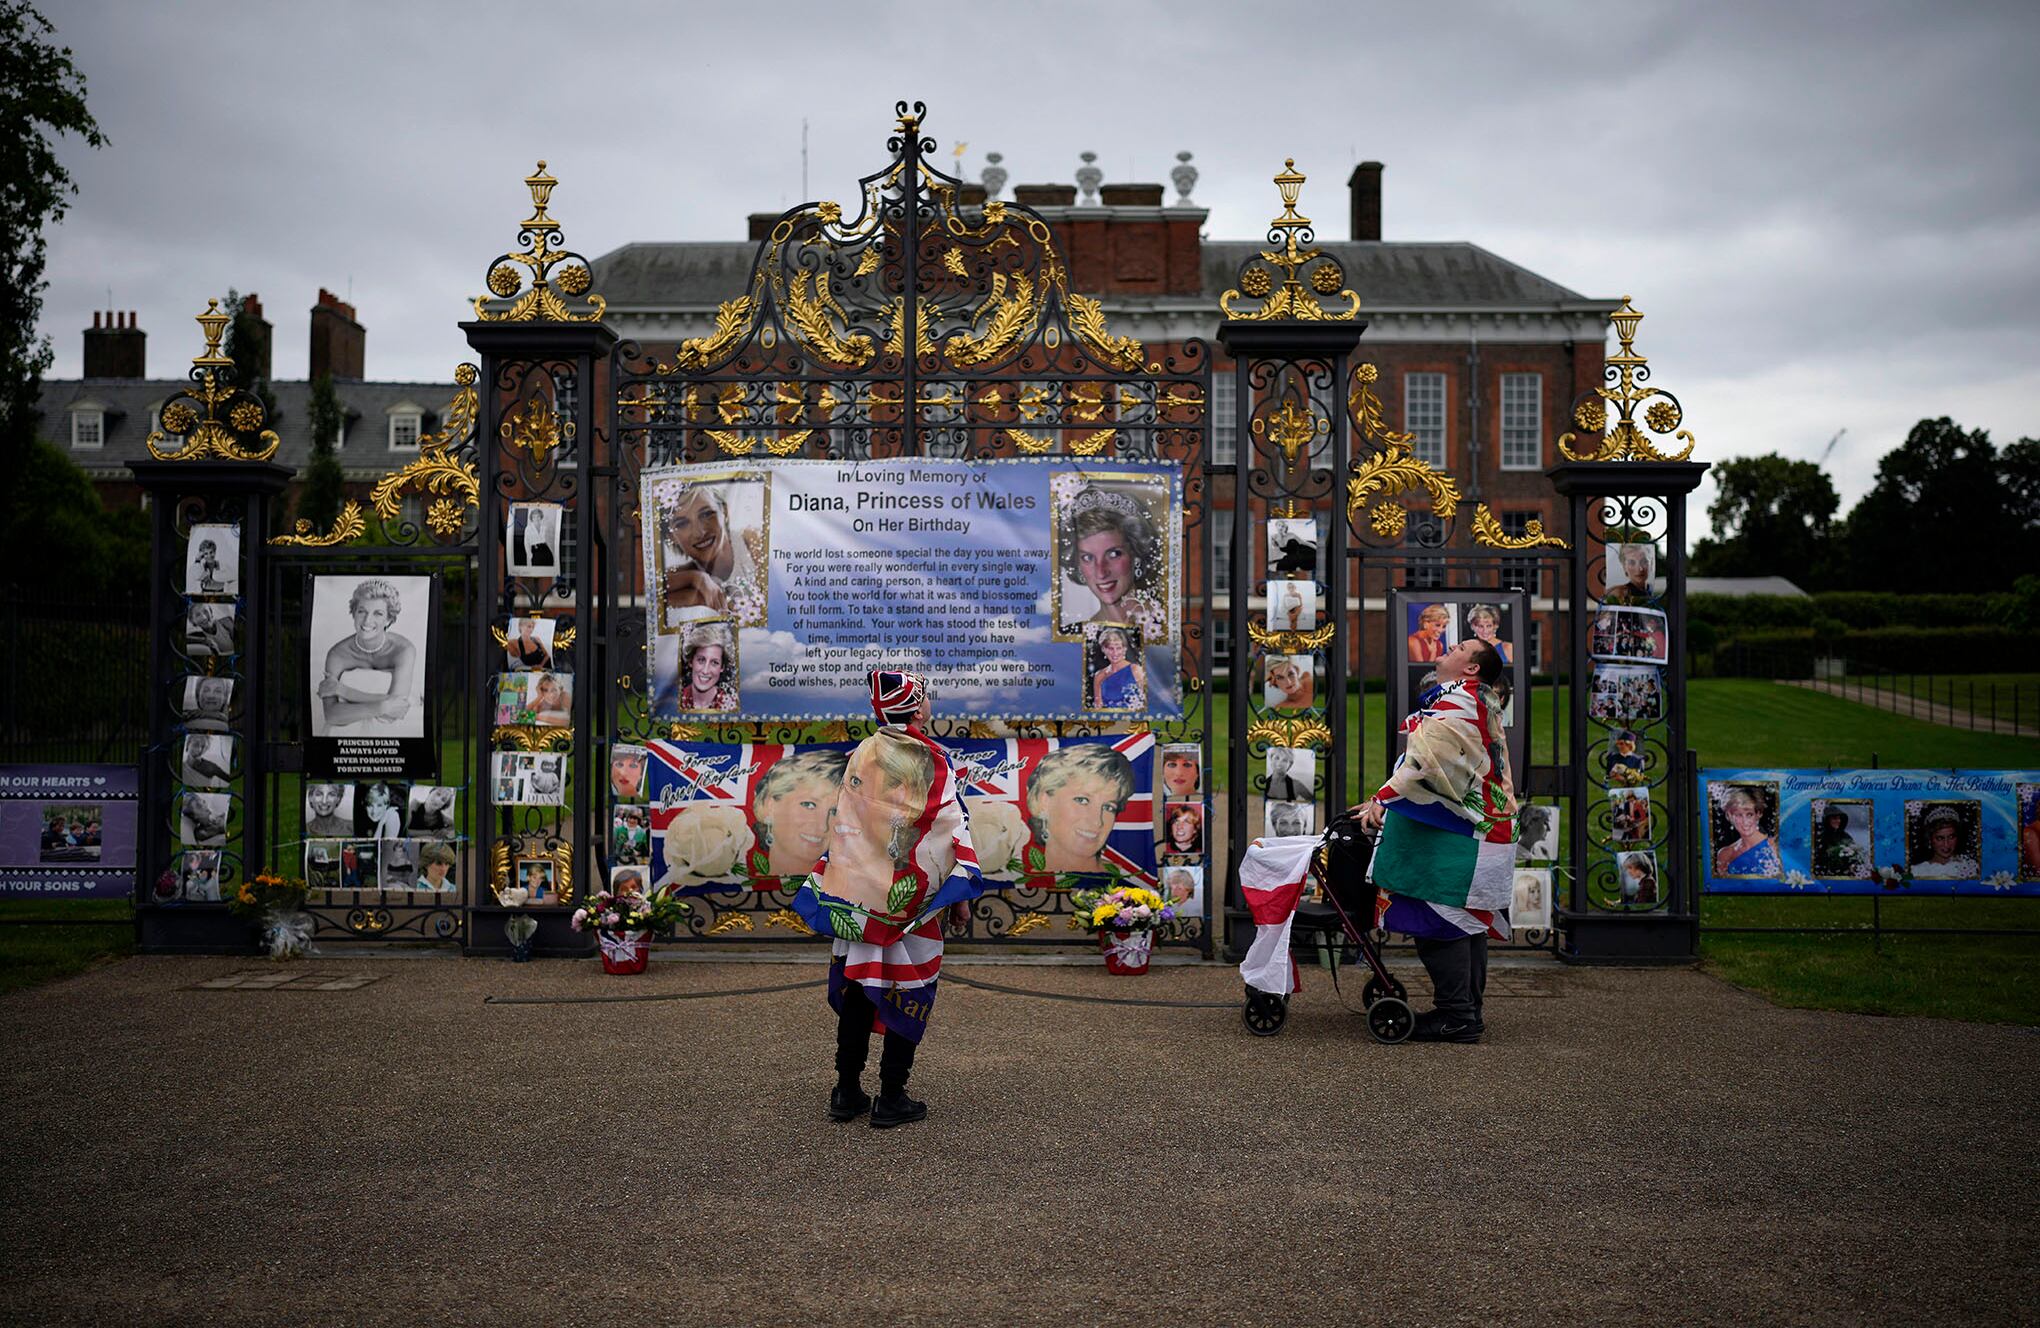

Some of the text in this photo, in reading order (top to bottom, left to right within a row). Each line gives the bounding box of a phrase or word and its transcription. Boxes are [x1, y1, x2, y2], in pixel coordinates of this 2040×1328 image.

[837, 469, 986, 486] In Loving Memory of
[789, 491, 1035, 513] Diana, Princess of Wales
[853, 518, 970, 534] On Her Birthday
[772, 548, 1051, 561] The world lost someone special the day you went away.
[786, 562, 1038, 576] For you were really wonderful in every single way.
[794, 576, 1028, 588] A kind and caring person, a heart of pure gold.
[785, 589, 1038, 601] You took the world for what it was and blossomed
[787, 604, 1036, 615] in full form. To take a stand and lend a hand to all
[793, 618, 1030, 630] of humankind. Your work has stood the test of
[808, 632, 1015, 646] time, immortal is your soul and you have
[805, 646, 1016, 660] left your legacy for those to champion on.
[769, 661, 1054, 674] Today we stop and celebrate the day that you were born.
[768, 676, 796, 687] Good
[798, 676, 836, 687] wishes,
[932, 678, 982, 689] everyone,
[985, 678, 1000, 686] we
[1002, 676, 1033, 686] salute
[1036, 678, 1054, 688] you
[681, 752, 731, 770] Forever
[702, 762, 761, 787] England
[972, 757, 1029, 783] England
[12, 777, 39, 787] OUR
[42, 777, 90, 787] HEARTS
[1783, 775, 2014, 796] Remembering Princess Diana On Her Birthday
[9, 881, 41, 891] YOUR
[44, 881, 80, 891] SONS
[884, 980, 930, 1021] Kat
